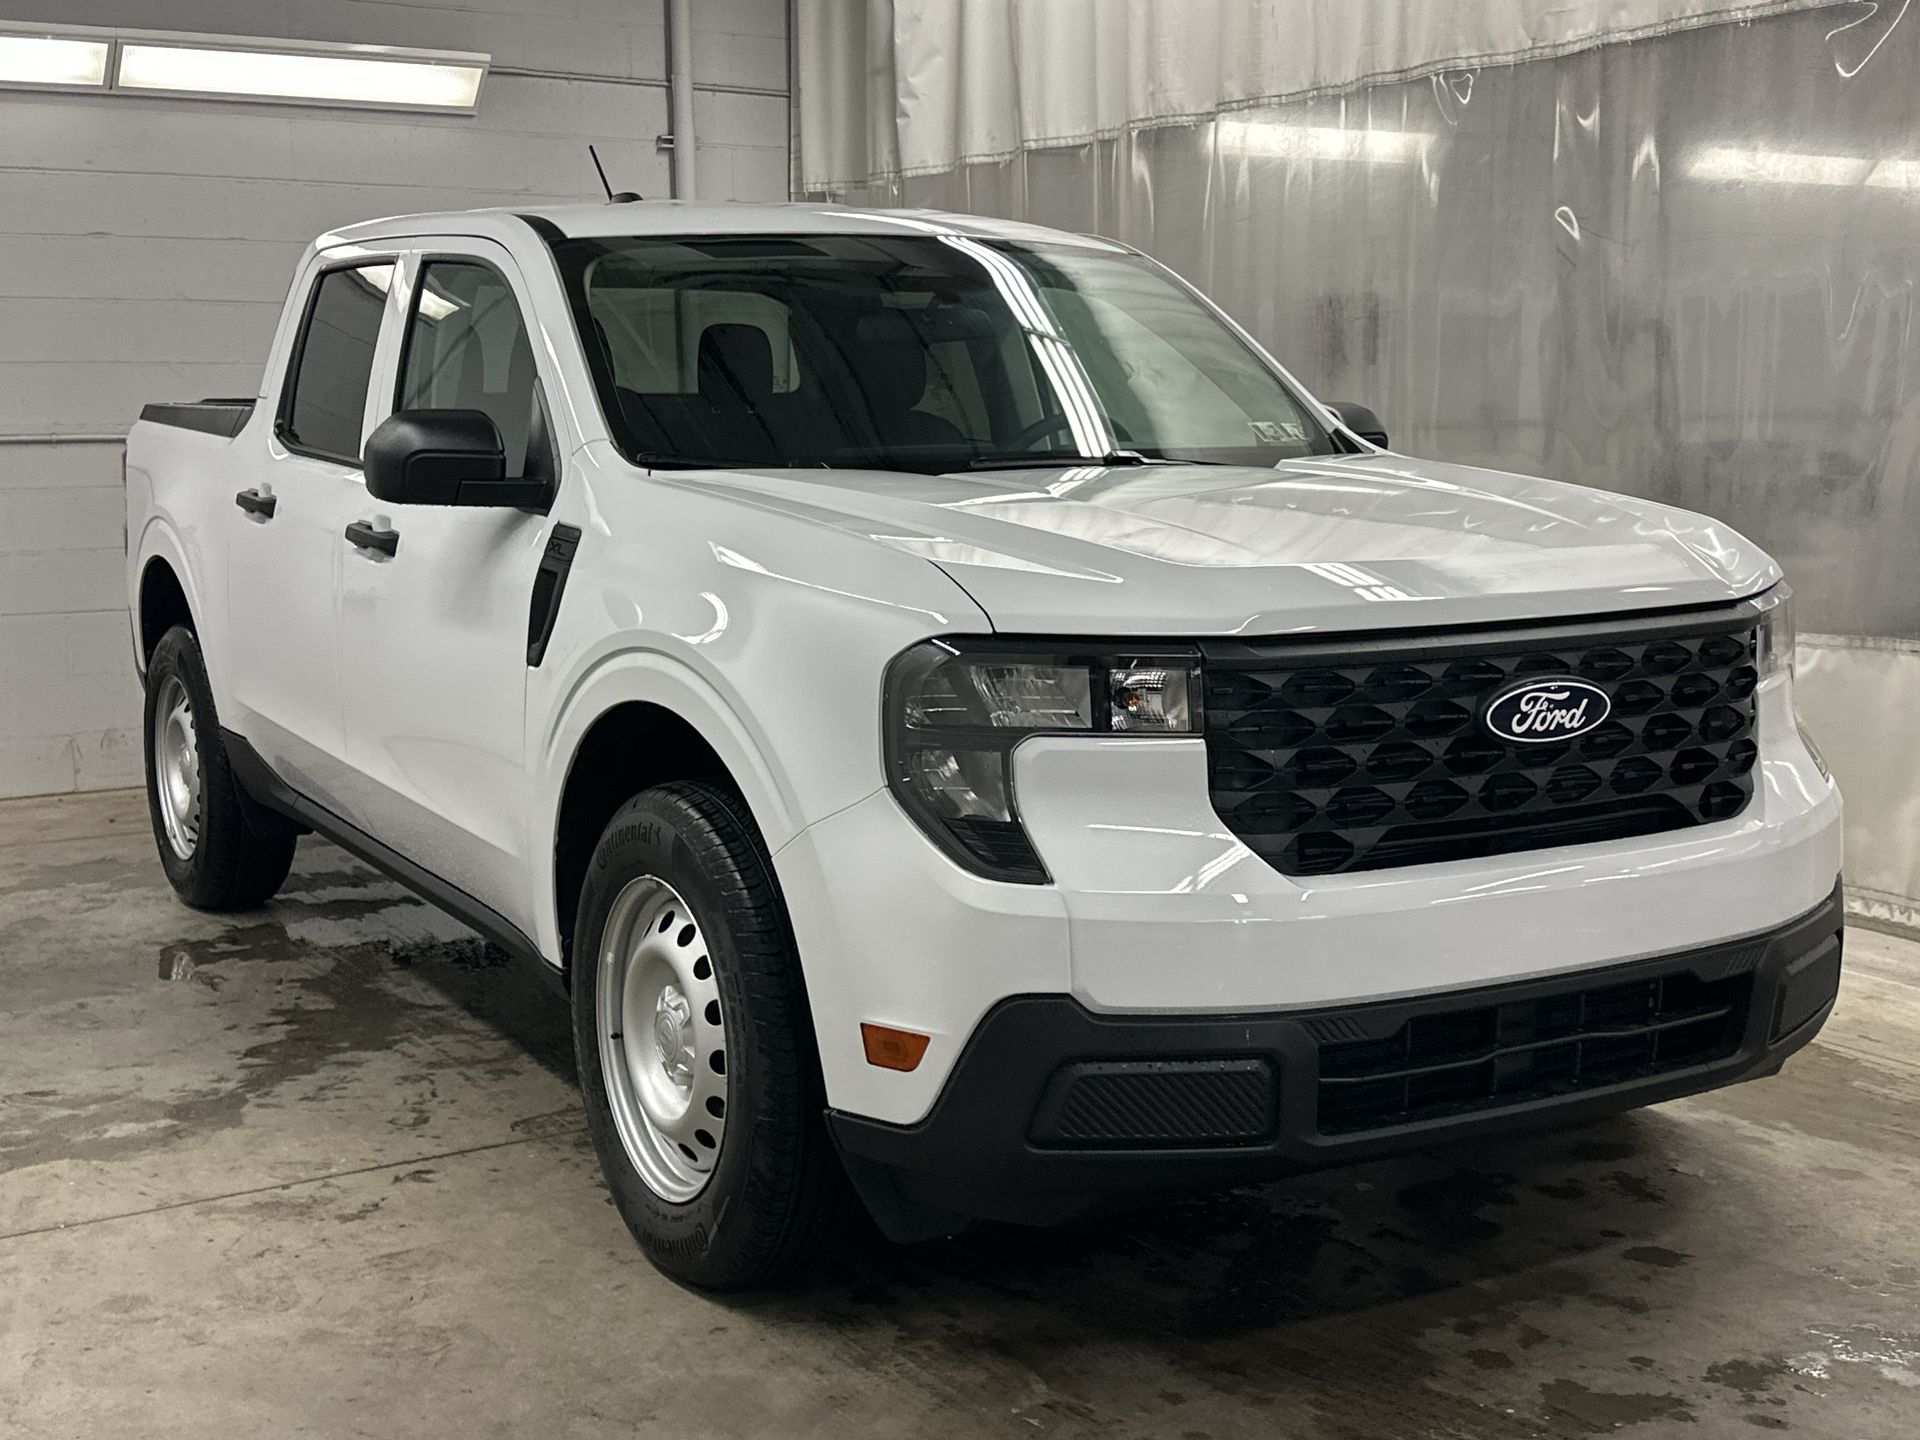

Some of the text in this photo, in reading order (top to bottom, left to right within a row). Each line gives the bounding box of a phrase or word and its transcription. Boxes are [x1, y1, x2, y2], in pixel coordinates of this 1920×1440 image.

[548, 540, 565, 556] XL
[1511, 691, 1589, 734] Ford
[597, 821, 654, 869] Continental
